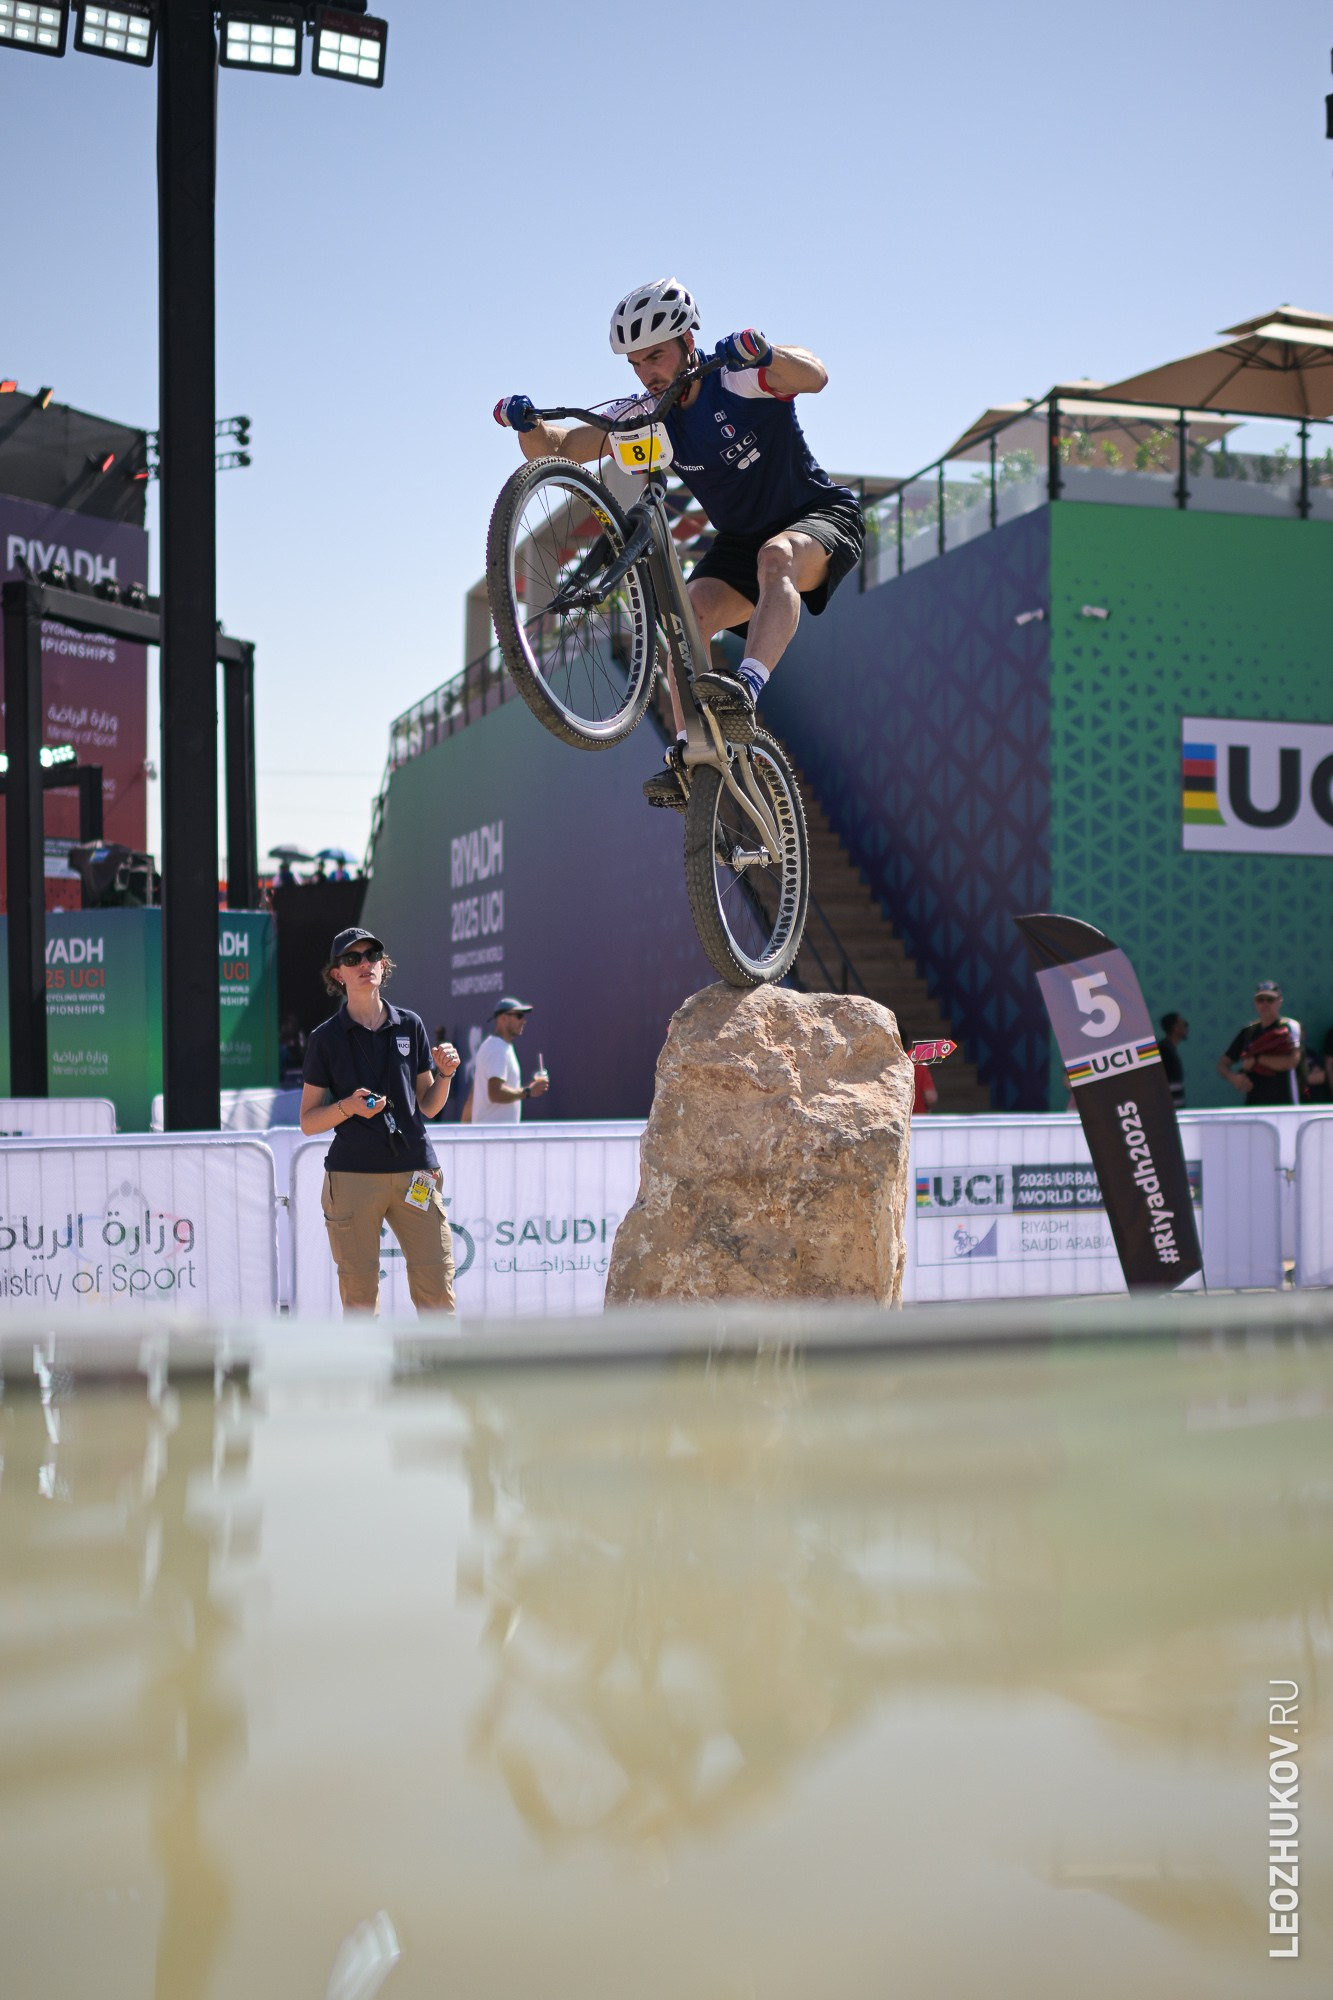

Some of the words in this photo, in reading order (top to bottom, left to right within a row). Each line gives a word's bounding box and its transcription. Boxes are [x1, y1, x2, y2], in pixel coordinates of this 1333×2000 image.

[632, 445, 646, 461] 8
[726, 435, 753, 459] CIC
[7, 534, 116, 586] RIYADH
[41, 637, 116, 663] PIONSHIPS
[451, 820, 503, 890] RIYADH
[451, 896, 479, 942] 2025
[480, 890, 503, 936] UCI
[45, 937, 103, 964] YADH
[45, 969, 65, 989] 25
[69, 968, 105, 989] UCI
[223, 962, 248, 981] UCI
[46, 1005, 105, 1015] PIONSHIPS
[1072, 971, 1121, 1038] 5
[1091, 1049, 1134, 1074] UCI
[933, 1175, 1004, 1207] UCI
[1020, 1173, 1052, 1187] 2025
[1117, 1101, 1181, 1264] #Riyadh2025
[1017, 1189, 1073, 1205] WORLD
[102, 1211, 194, 1256] وزارة
[495, 1219, 606, 1246] SAUDI
[1021, 1220, 1069, 1234] RIYADH
[1021, 1237, 1062, 1252] SAUDI
[1066, 1236, 1114, 1250] ARABIA
[0, 1267, 62, 1301] istry
[72, 1265, 103, 1294] of
[112, 1260, 196, 1297] Sport
